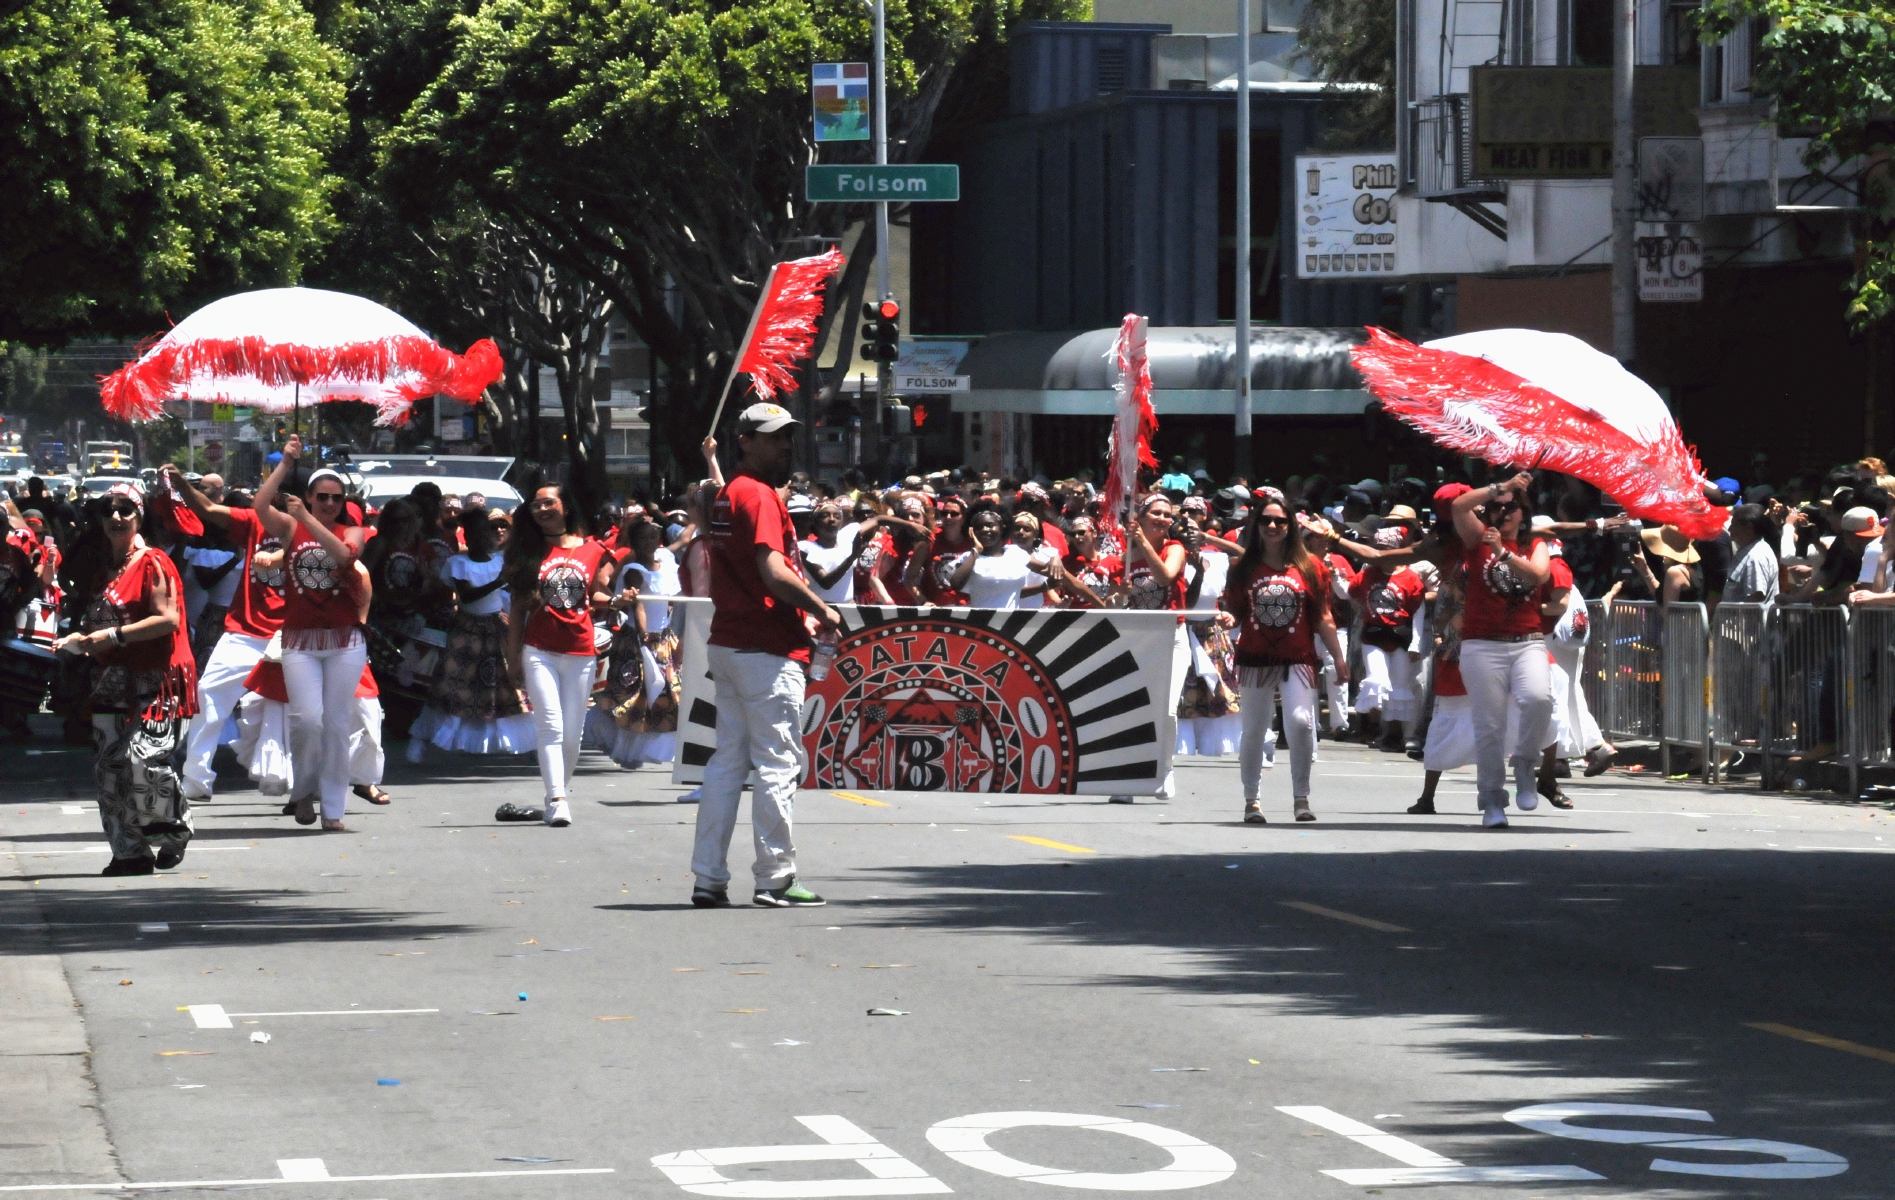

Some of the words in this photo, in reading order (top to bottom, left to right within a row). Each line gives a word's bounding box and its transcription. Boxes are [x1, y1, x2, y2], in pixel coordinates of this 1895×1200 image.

[1491, 148, 1540, 169] MEAT
[1549, 148, 1592, 169] FISH
[838, 174, 927, 192] Folsom
[1353, 233, 1375, 245] ONE
[1375, 233, 1395, 245] CUP
[1644, 278, 1660, 287] MON
[1683, 278, 1698, 288] FRI
[906, 378, 957, 388] FOLSOM
[835, 635, 1011, 689] BATALA
[651, 1102, 1850, 1198] STOP
